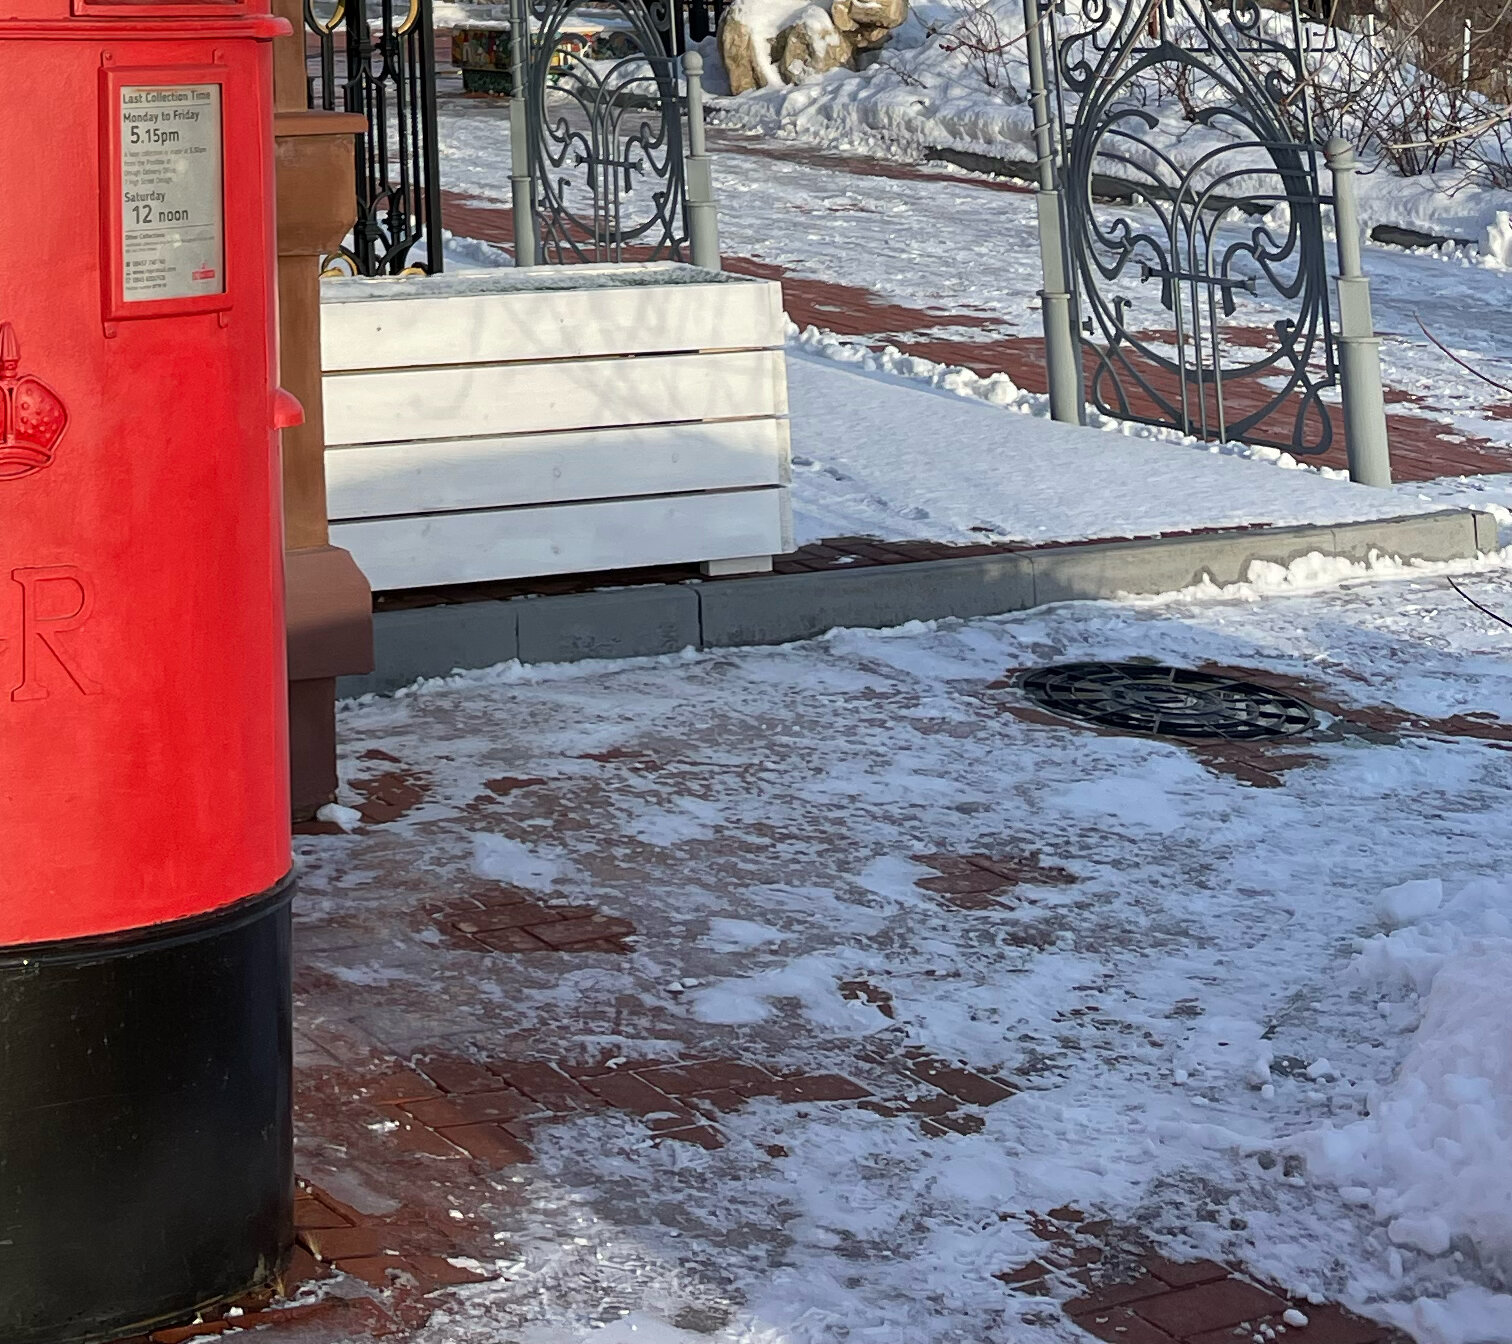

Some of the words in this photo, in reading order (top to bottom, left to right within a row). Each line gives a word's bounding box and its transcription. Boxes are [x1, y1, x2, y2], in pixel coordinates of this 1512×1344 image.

[123, 94, 143, 104] Last
[146, 91, 188, 103] Collection
[191, 91, 210, 101] Time
[123, 112, 158, 124] Monday
[161, 112, 170, 121] to
[173, 110, 199, 122] Friday
[130, 125, 180, 146] 5.15pm
[124, 190, 166, 202] Saturday
[132, 204, 152, 224] 12
[158, 210, 189, 222] noon
